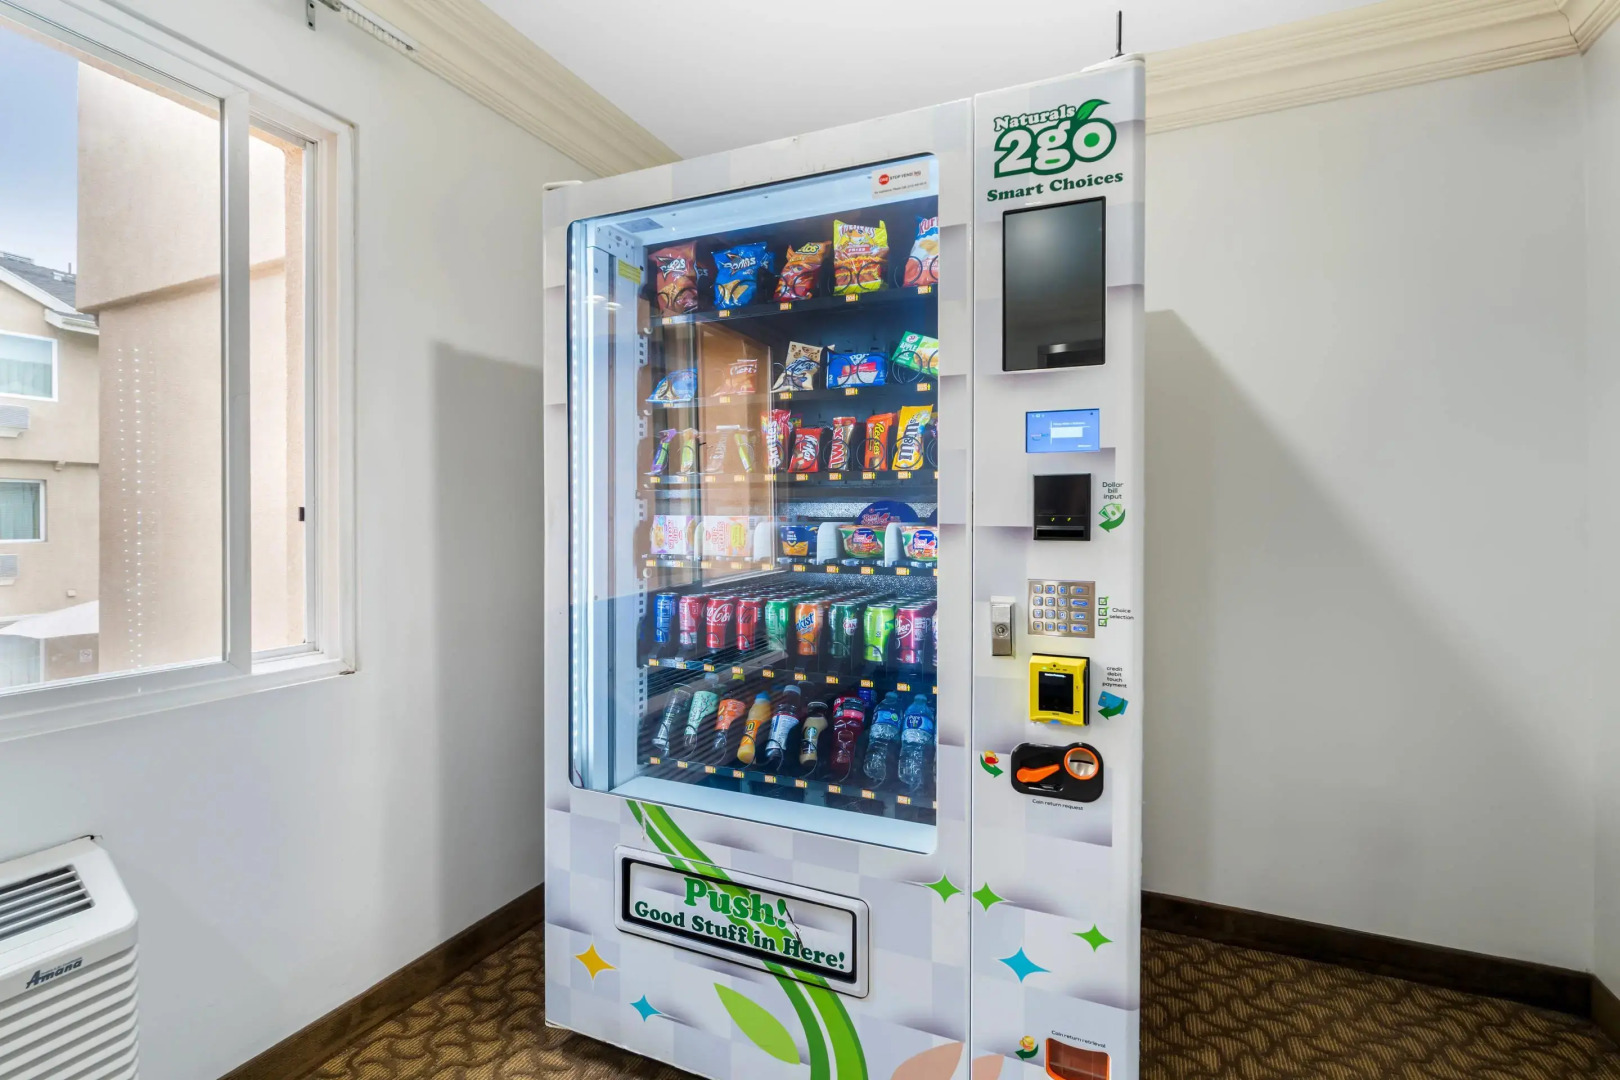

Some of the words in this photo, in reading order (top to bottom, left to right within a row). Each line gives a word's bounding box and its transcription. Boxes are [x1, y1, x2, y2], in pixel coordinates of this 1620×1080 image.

[994, 104, 1077, 132] Naturals
[994, 112, 1117, 179] 2go
[986, 183, 1044, 202] Smart
[1049, 172, 1124, 193] Choices
[684, 877, 787, 930] Push!
[634, 901, 685, 929] Good
[691, 916, 749, 945] Stuff
[753, 930, 776, 951] in
[783, 937, 845, 970] Here!
[26, 959, 83, 989] Amana
[1051, 1030, 1064, 1038] Coin
[1064, 1034, 1082, 1042] return
[1082, 1038, 1106, 1049] retrieval
